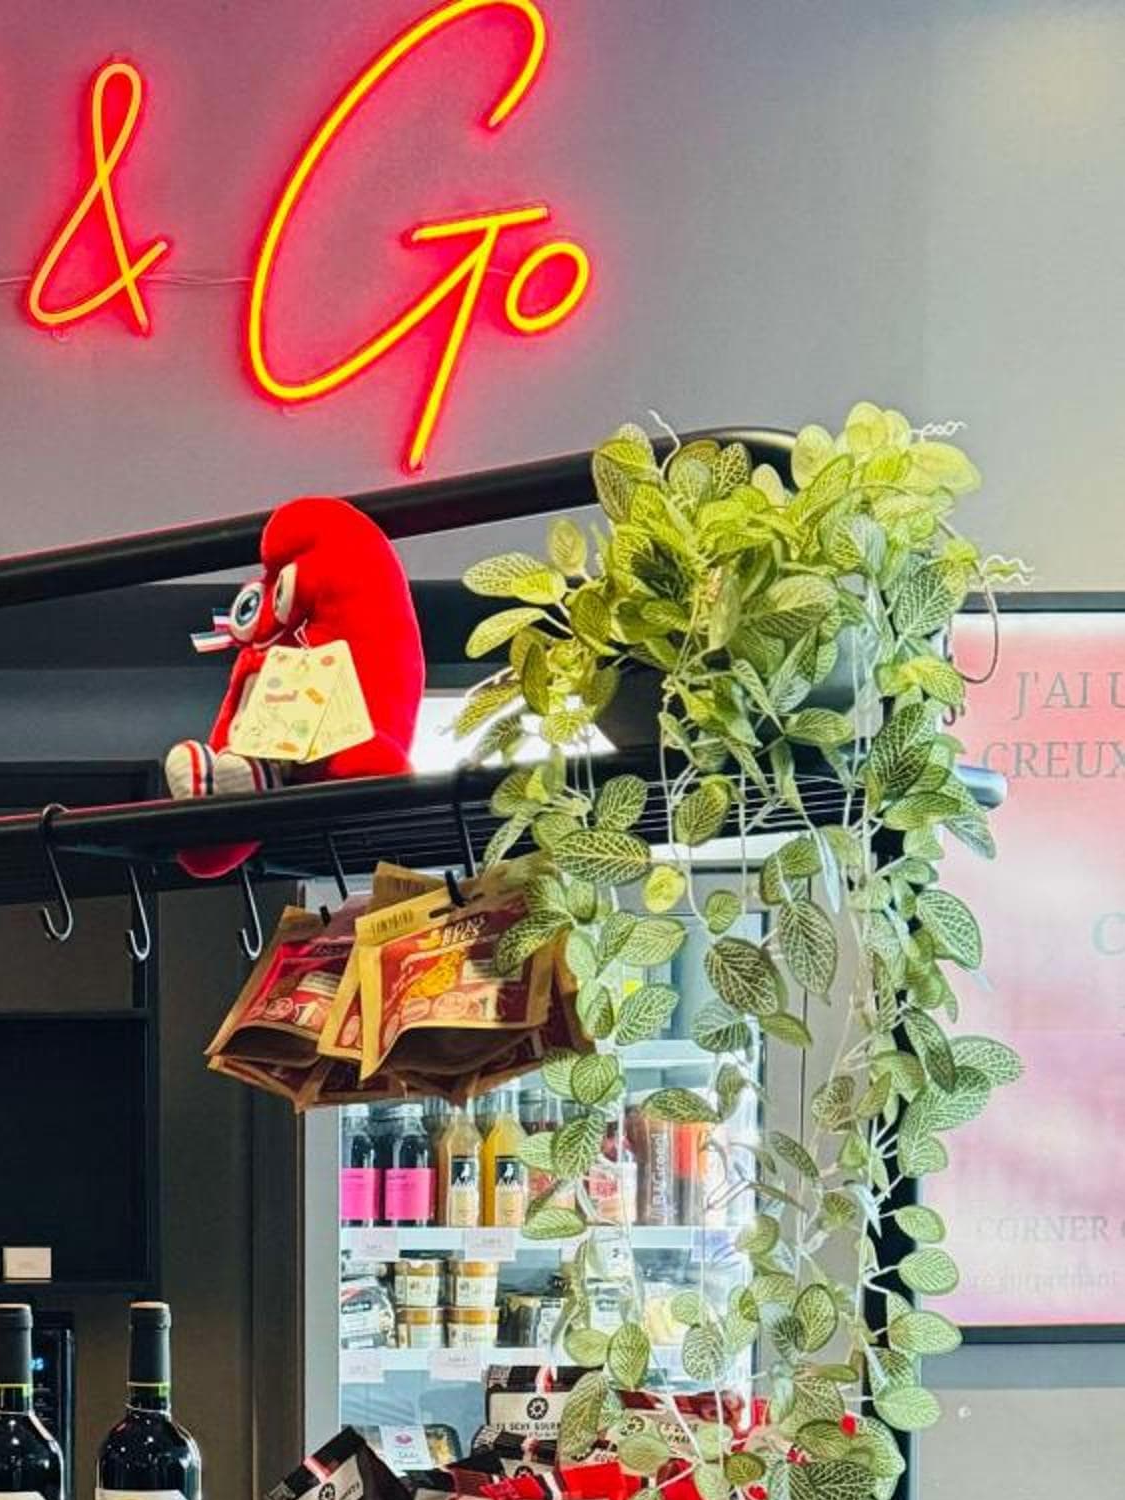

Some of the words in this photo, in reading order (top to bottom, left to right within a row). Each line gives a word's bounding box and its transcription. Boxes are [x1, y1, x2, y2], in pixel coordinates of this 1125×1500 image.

[25, 60, 168, 335] &
[247, 0, 593, 472] Go
[1014, 671, 1089, 720] J'AI
